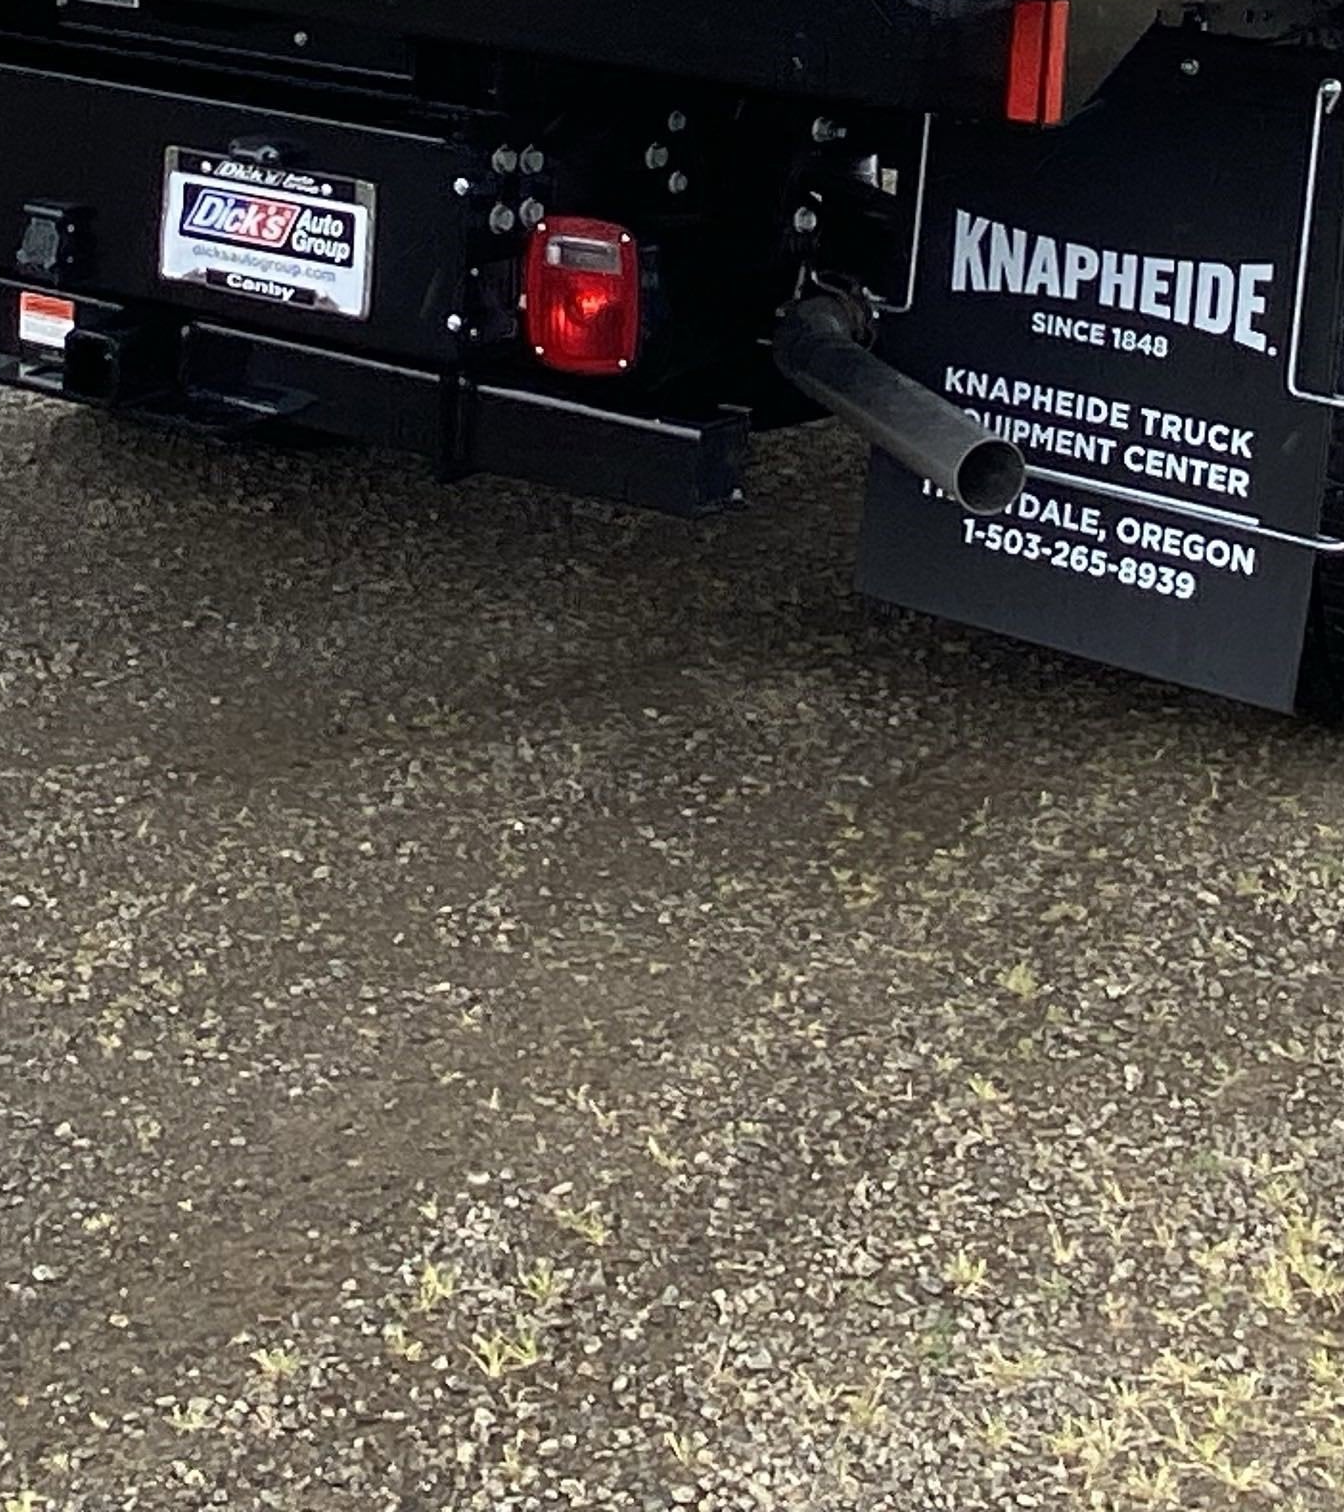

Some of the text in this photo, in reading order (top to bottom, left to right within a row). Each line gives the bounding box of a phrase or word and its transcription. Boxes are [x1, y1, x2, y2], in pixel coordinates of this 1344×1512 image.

[193, 194, 291, 241] Dick's
[296, 209, 344, 238] Auto
[192, 244, 337, 282] dicksautogroup.com
[291, 230, 351, 263] Group
[226, 273, 296, 302] Canby
[1031, 311, 1169, 358] SINCE 1848
[944, 366, 1254, 459] KNAPHEIDE TRUCK
[964, 408, 1250, 497] UIPMENT CENTER
[962, 518, 1196, 600] 1-503-265-8939
[1116, 517, 1256, 576] OREGON
